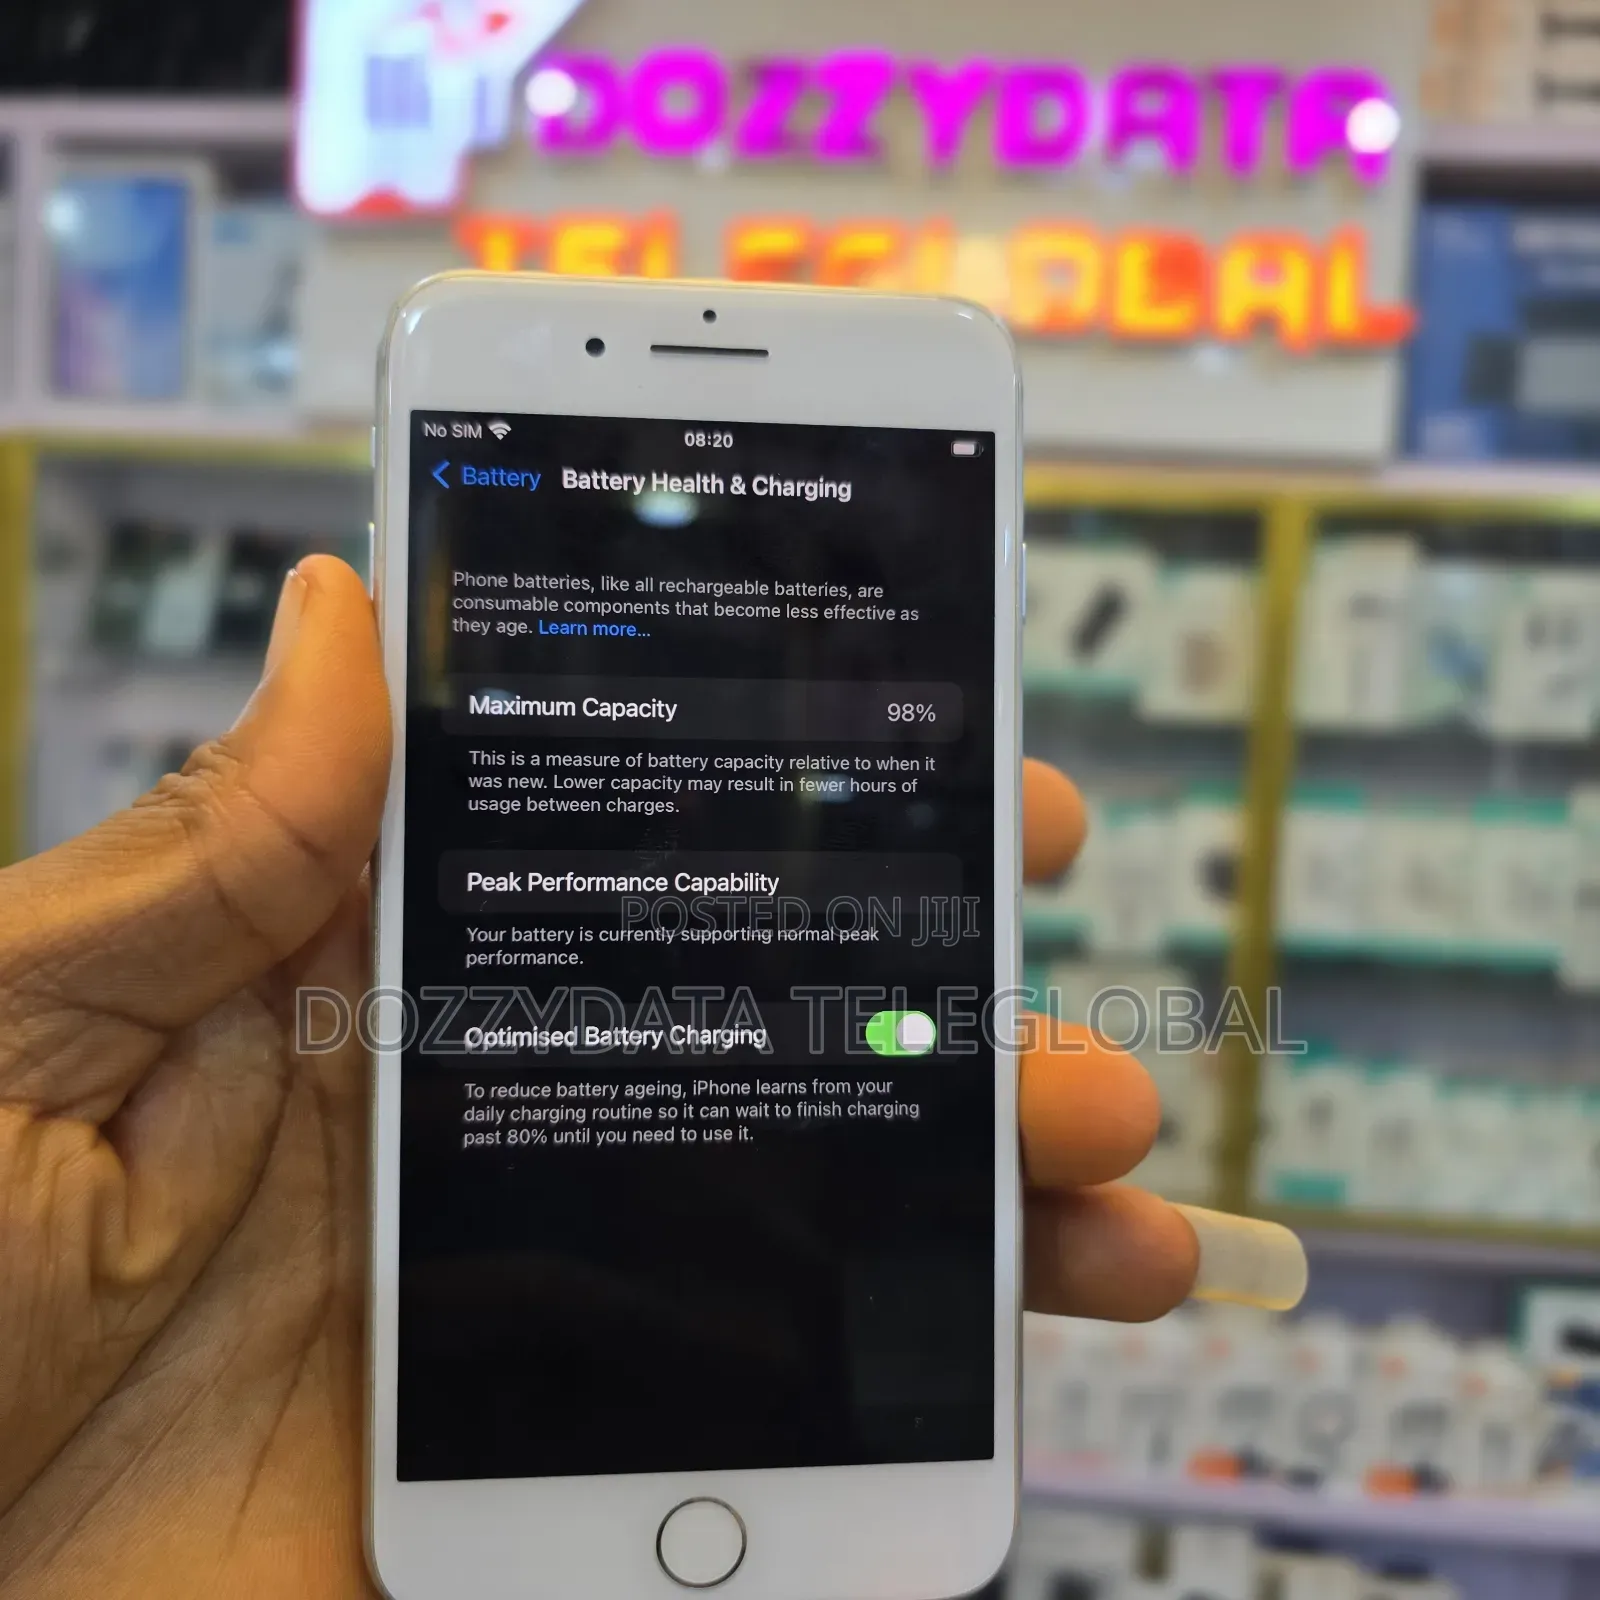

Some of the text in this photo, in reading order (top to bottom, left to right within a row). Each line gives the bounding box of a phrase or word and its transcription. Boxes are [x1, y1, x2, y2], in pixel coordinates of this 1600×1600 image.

[530, 46, 1395, 186] DOZZYDATA
[423, 423, 483, 439] No SIM
[684, 431, 733, 448] 08:20
[461, 466, 541, 491] Battery
[561, 467, 852, 502] Battery Health & Charging
[453, 571, 884, 600] Phone batteries, like all rechargeable batteries, are
[453, 596, 919, 621] consumable components that become less effective as
[453, 617, 490, 635] they
[496, 620, 533, 636] age.
[539, 619, 587, 635] Learn
[469, 695, 678, 722] Maximum Capacity
[887, 703, 936, 722] 98%
[469, 751, 935, 772] This is a measure of battery capacity relative to when it
[469, 775, 918, 793] was new. Lower capacity may result in fewer hours of
[469, 797, 680, 815] usage between charges.
[466, 872, 780, 896] Peak Performance Capability
[466, 926, 880, 945] Your battery is currently supporting normal peak
[466, 951, 584, 968] performance.
[464, 1024, 767, 1052] Optimised Battery Charging
[465, 1078, 893, 1100] To reduce battery ageing, iPhone learns from your
[463, 1100, 920, 1124] daily charging routine so it can wait to finish charging
[463, 1125, 753, 1148] past 80% until you need to use it.
